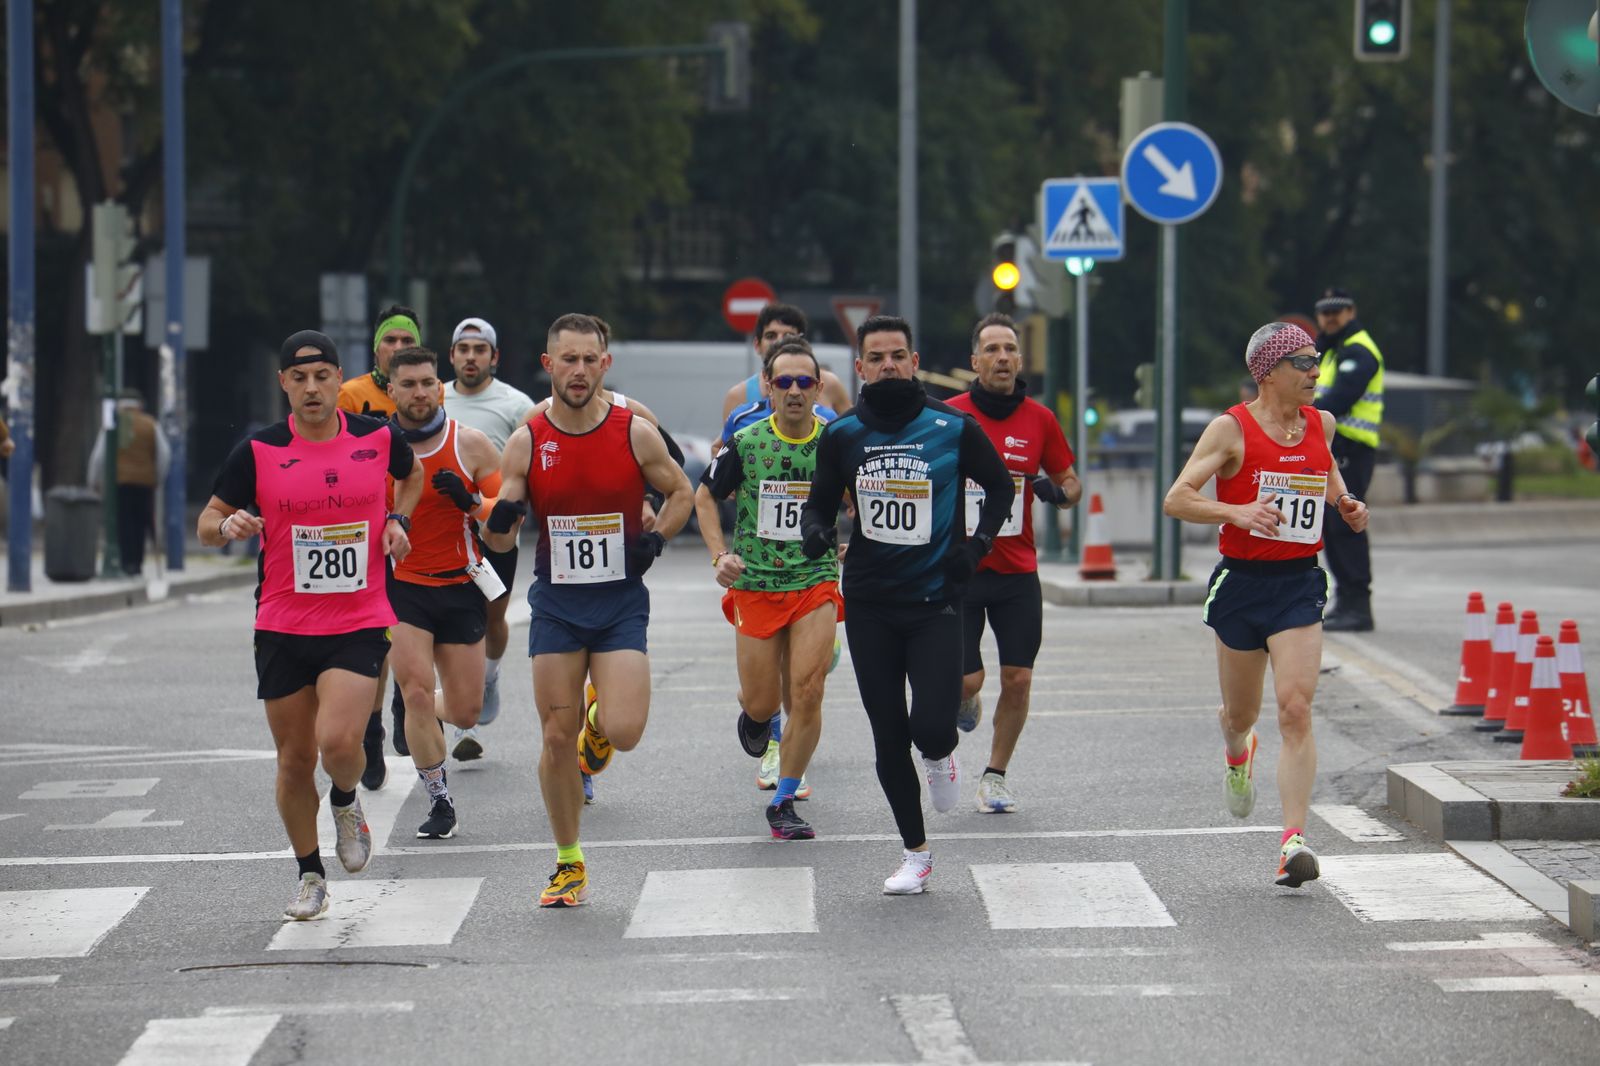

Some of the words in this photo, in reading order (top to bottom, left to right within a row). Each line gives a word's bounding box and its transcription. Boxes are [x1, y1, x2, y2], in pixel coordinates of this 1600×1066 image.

[858, 479, 886, 491] XXXIX
[1263, 474, 1290, 488] XXXIX
[551, 519, 577, 530] XXXIX
[774, 501, 804, 529] 15
[870, 499, 916, 531] 200
[1275, 496, 1316, 530] 119
[308, 547, 357, 580] 280
[565, 537, 608, 570] 181
